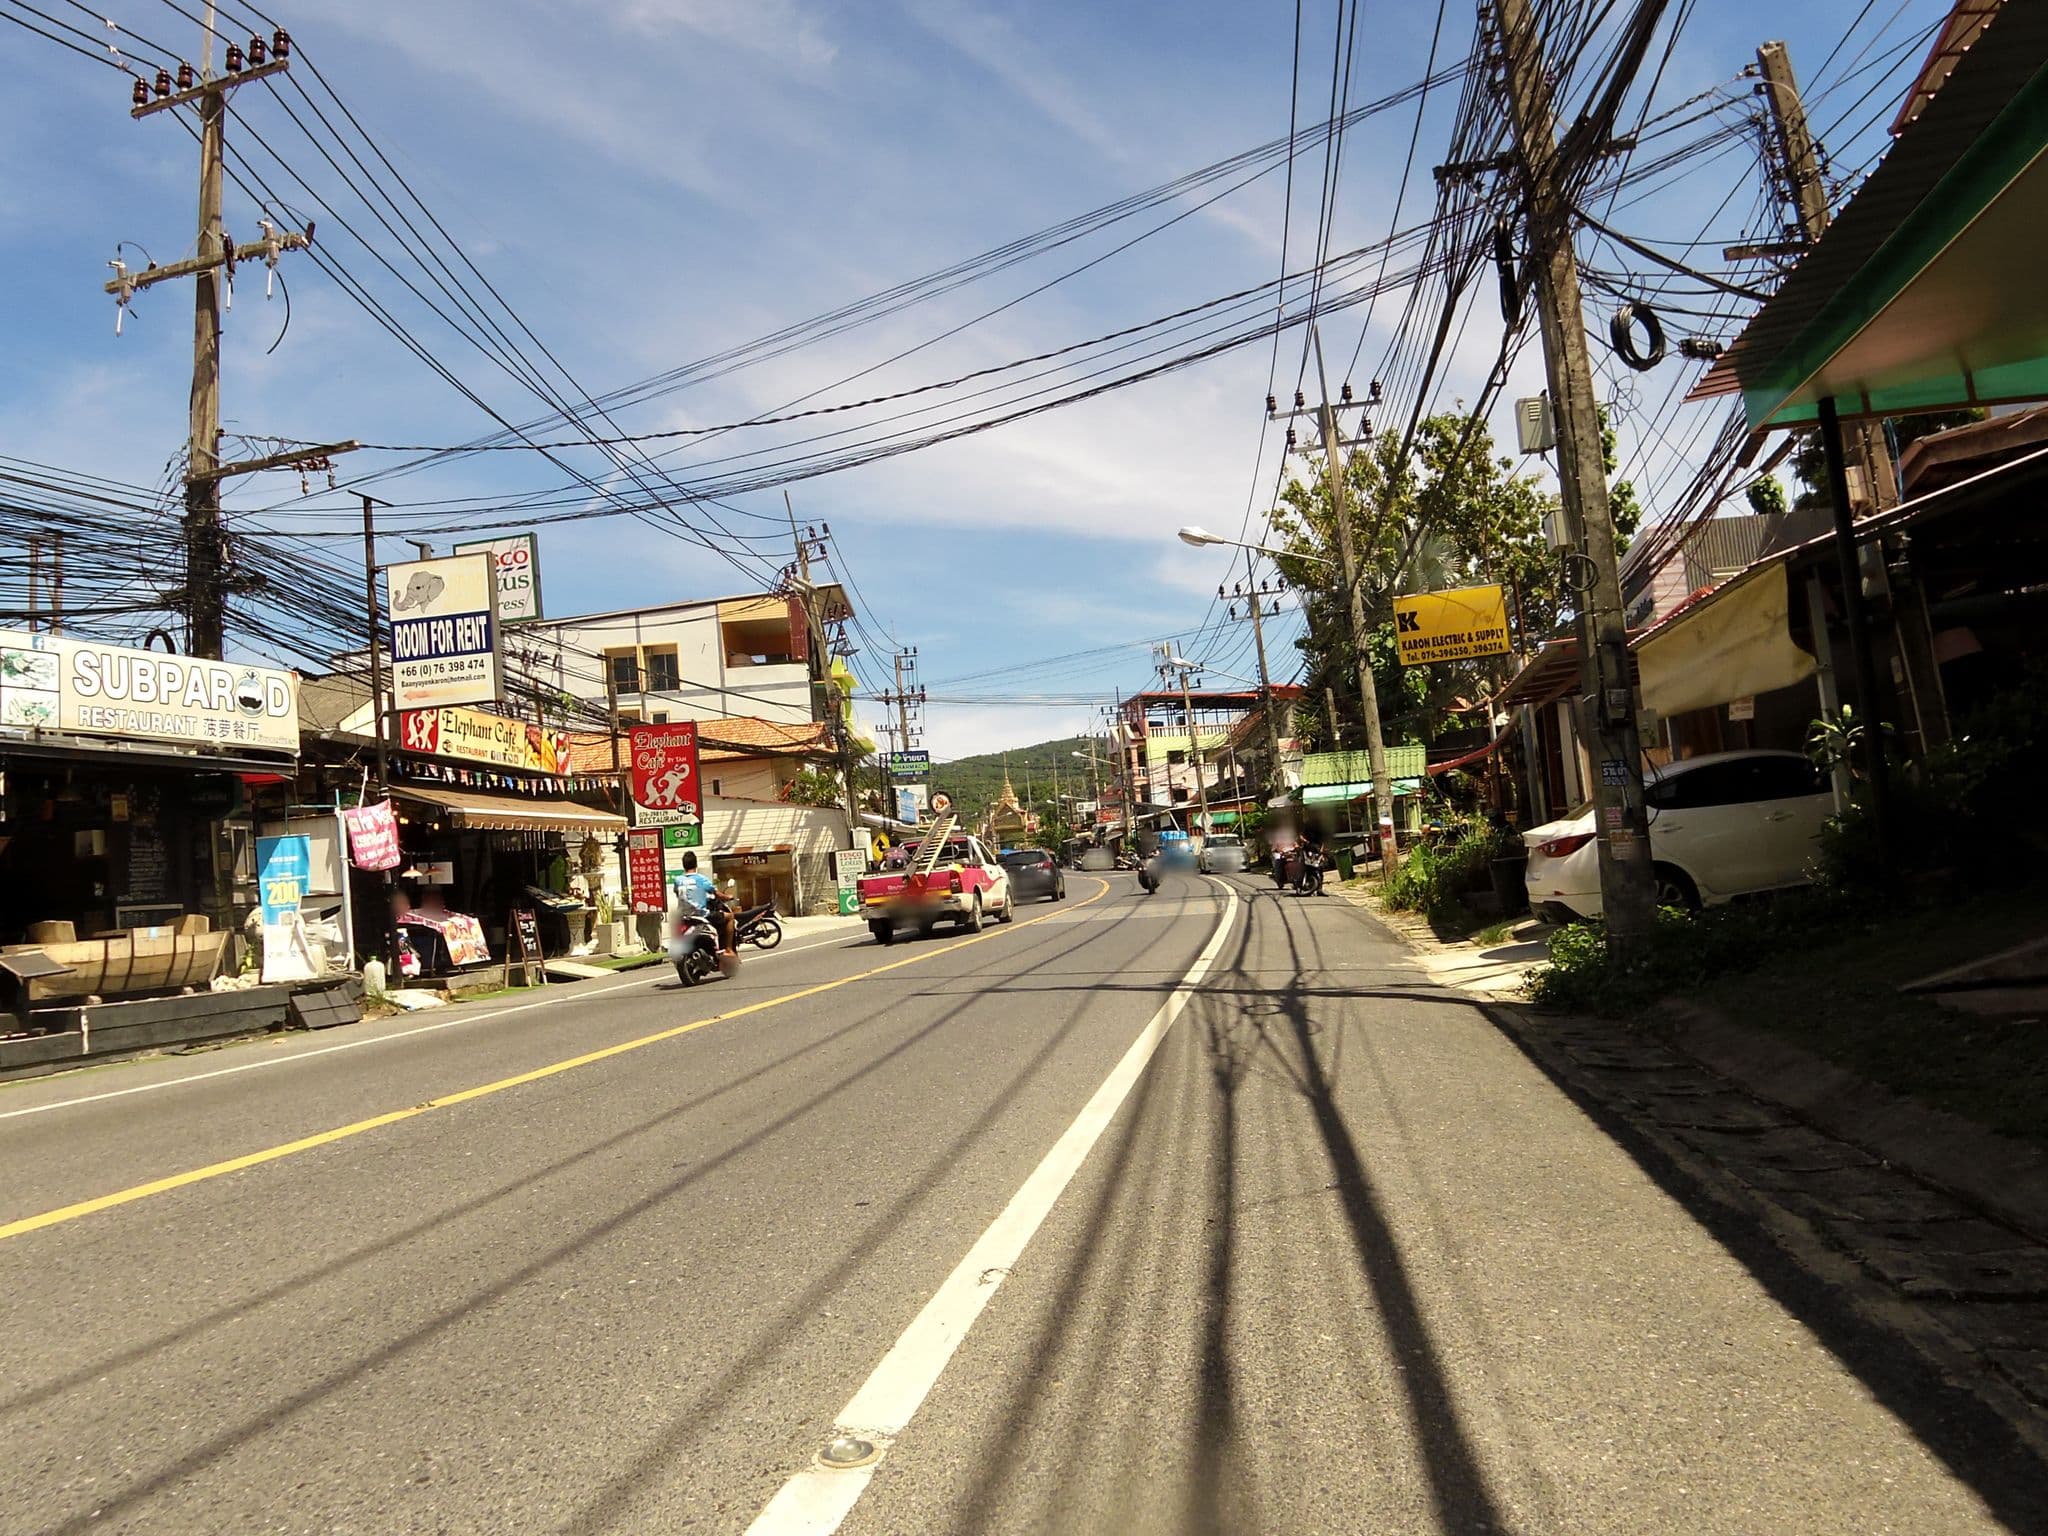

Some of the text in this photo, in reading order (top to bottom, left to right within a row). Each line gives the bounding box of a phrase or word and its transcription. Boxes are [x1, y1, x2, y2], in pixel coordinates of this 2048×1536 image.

[1396, 611, 1420, 633] K
[394, 615, 487, 659] ROOM FOR RENT
[1402, 628, 1504, 651] KARON ELECTRIC & SUPPLY
[401, 659, 485, 677] +66 (0) 76 398 474
[1407, 653, 1419, 663] Tel.
[78, 705, 198, 736] RESTAURANT
[203, 718, 259, 741] 菠萝餐厅
[442, 710, 517, 751] Elephant Café
[456, 745, 488, 757] RESTAURANT
[634, 732, 692, 750] Elephant
[638, 815, 684, 825] RESTAURANT
[266, 881, 300, 905] 200
